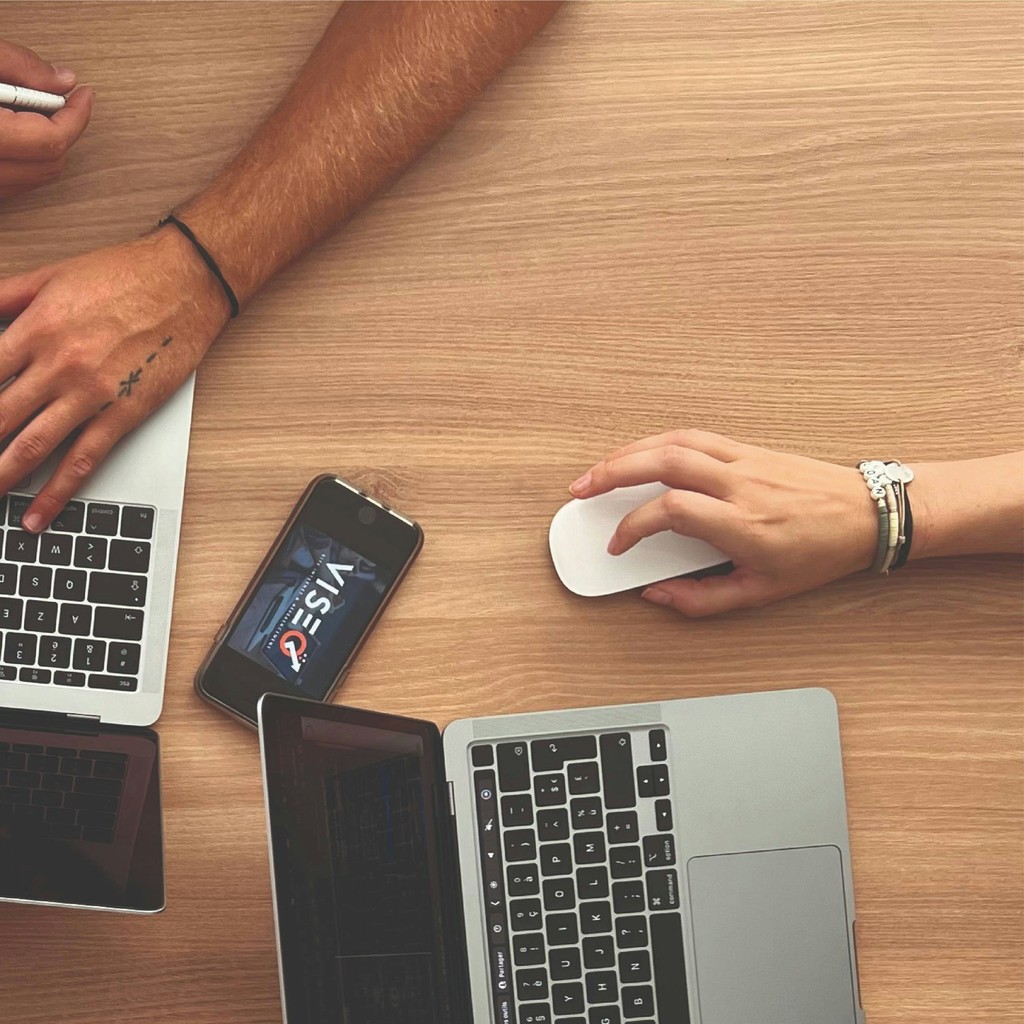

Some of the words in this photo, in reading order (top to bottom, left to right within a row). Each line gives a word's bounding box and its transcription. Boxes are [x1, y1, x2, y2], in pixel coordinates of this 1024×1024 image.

[18, 542, 25, 551] X
[51, 545, 61, 554] W
[32, 577, 39, 587] S
[66, 580, 74, 590] Q
[3, 609, 9, 618] E
[37, 612, 44, 621] Z
[72, 615, 79, 624] A
[16, 650, 23, 659] 3
[50, 653, 57, 663] 2
[586, 843, 594, 852] M
[666, 873, 675, 905] command
[497, 951, 505, 978] Partager
